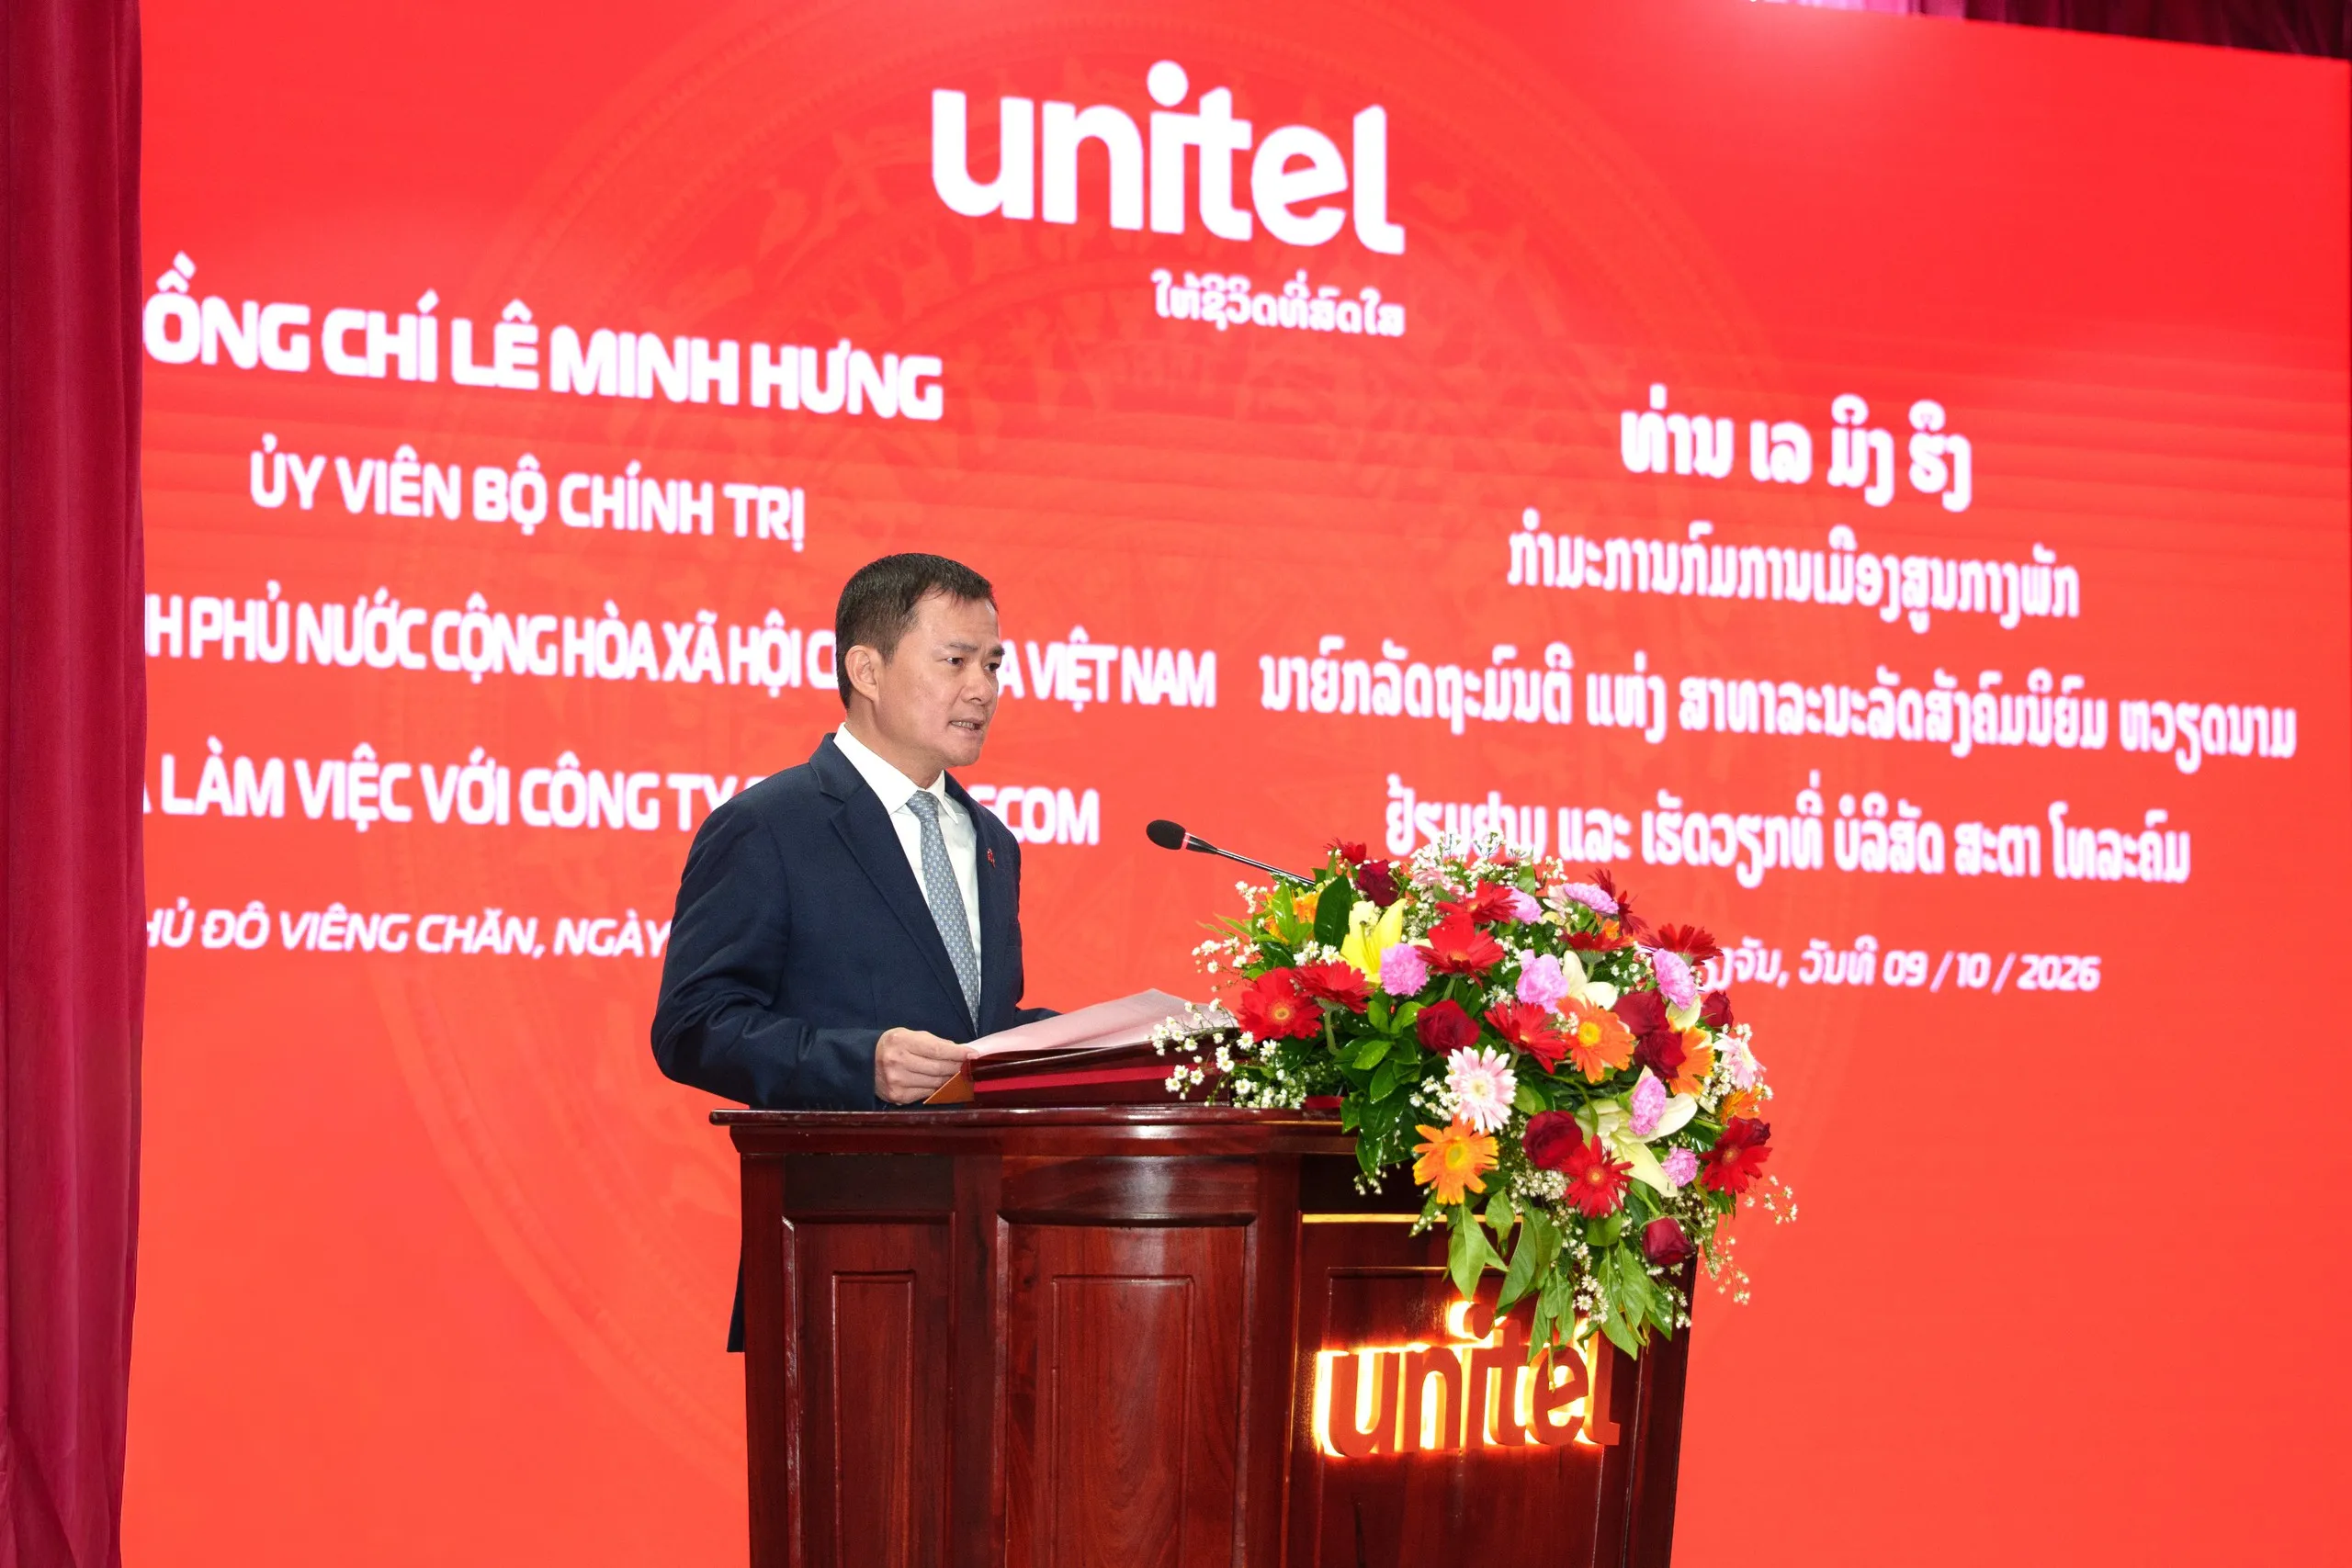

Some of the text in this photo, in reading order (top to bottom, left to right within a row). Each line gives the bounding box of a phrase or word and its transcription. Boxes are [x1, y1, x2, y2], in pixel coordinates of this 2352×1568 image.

[932, 60, 1406, 255] unitel
[142, 251, 944, 421] ỒNG CHÍ LÊ MINH HƯNG
[250, 433, 806, 553] ỦY VIÊN BỘ CHÍNH TRỊ
[1620, 383, 1735, 479] ທ່ານ
[1749, 421, 1813, 484] ເລ
[1826, 394, 1894, 507] ມິງ
[189, 580, 290, 663] PHỦ
[295, 586, 428, 671] NƯỚC
[430, 591, 559, 684] CỘNG
[562, 599, 661, 682] HÒA
[661, 608, 726, 684] XÃ
[728, 607, 803, 699] HỘI
[1024, 625, 1120, 713] VIỆT
[1120, 645, 1217, 708] NAM
[1586, 649, 1668, 745] ແຫ່ງ
[2119, 700, 2297, 775] ຫວຽດນາມ
[161, 735, 739, 833] LÀM VIỆC VỚI CÔNG TY
[1557, 807, 1634, 864] ແລະ
[2048, 800, 2191, 884] ໂທລະຄົມ
[144, 896, 673, 959] HỦ ĐÔ VIÊNG CHĂN, NGÀY
[1323, 1301, 1621, 1459] unitel
